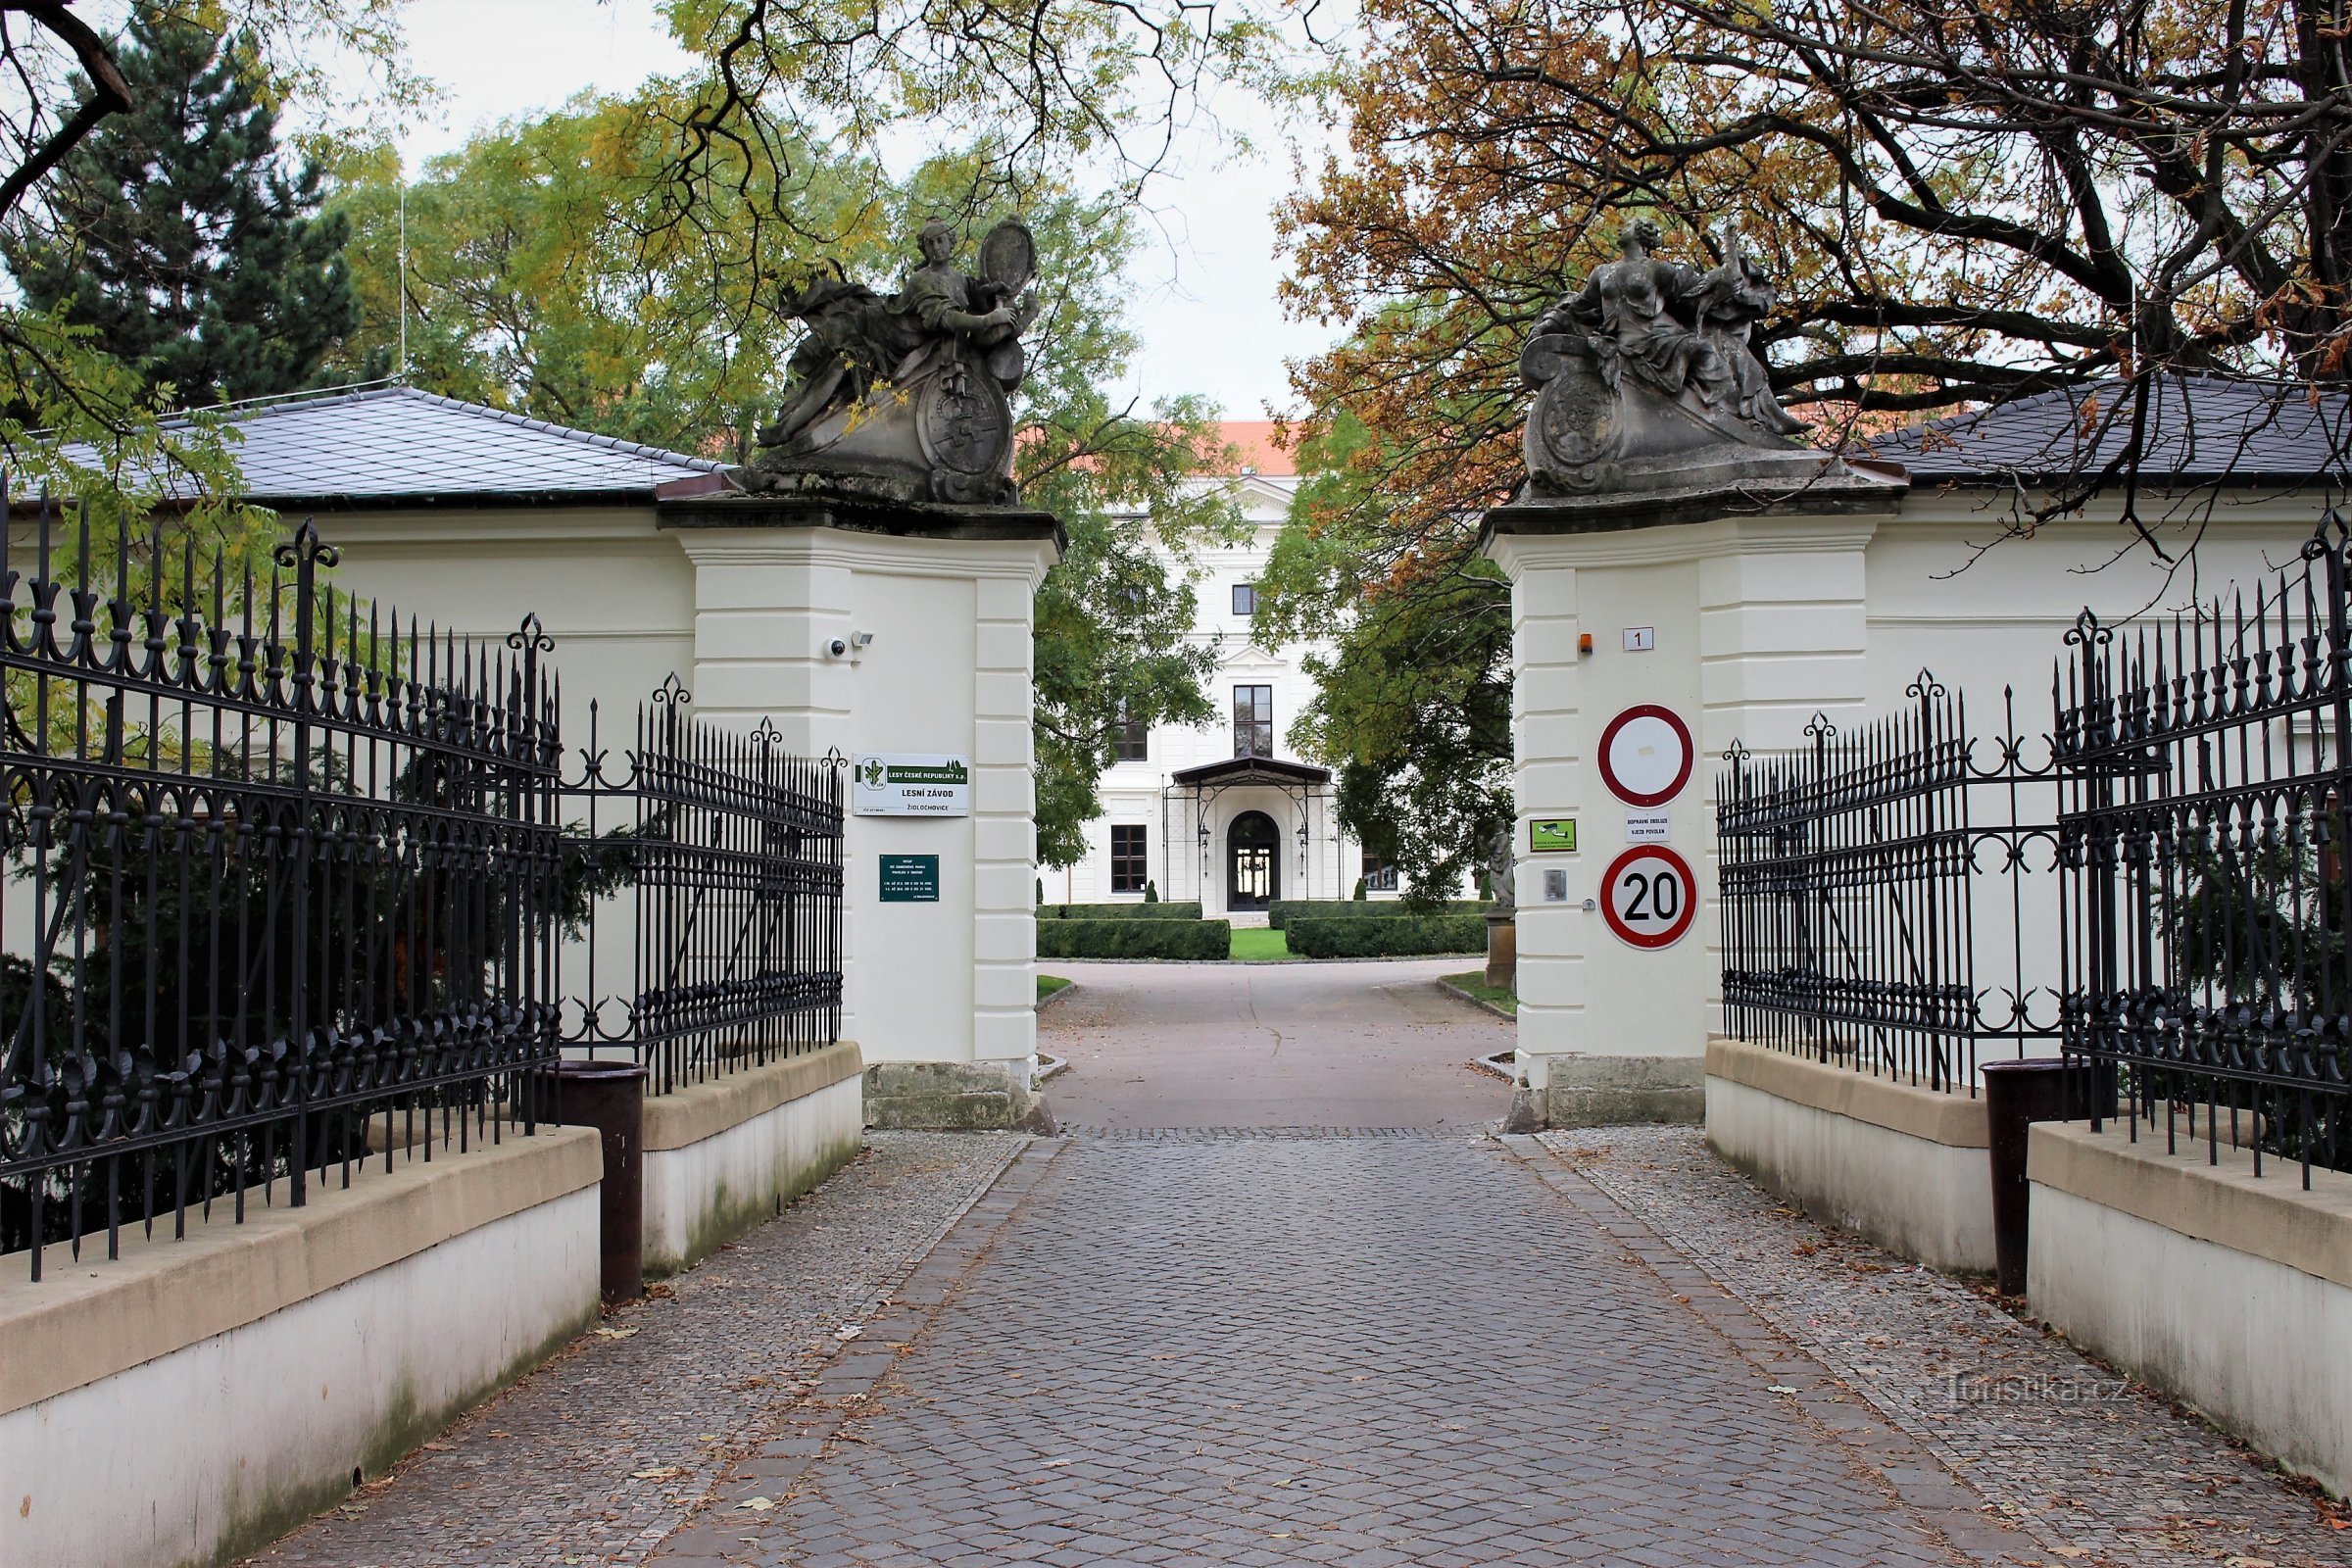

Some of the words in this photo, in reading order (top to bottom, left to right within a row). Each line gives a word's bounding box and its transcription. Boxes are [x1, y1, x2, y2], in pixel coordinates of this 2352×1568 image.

[1635, 632, 1641, 646] 1
[902, 788, 925, 797] LESNÍ
[927, 789, 954, 798] ZÁVOD
[1623, 871, 1678, 920] 20
